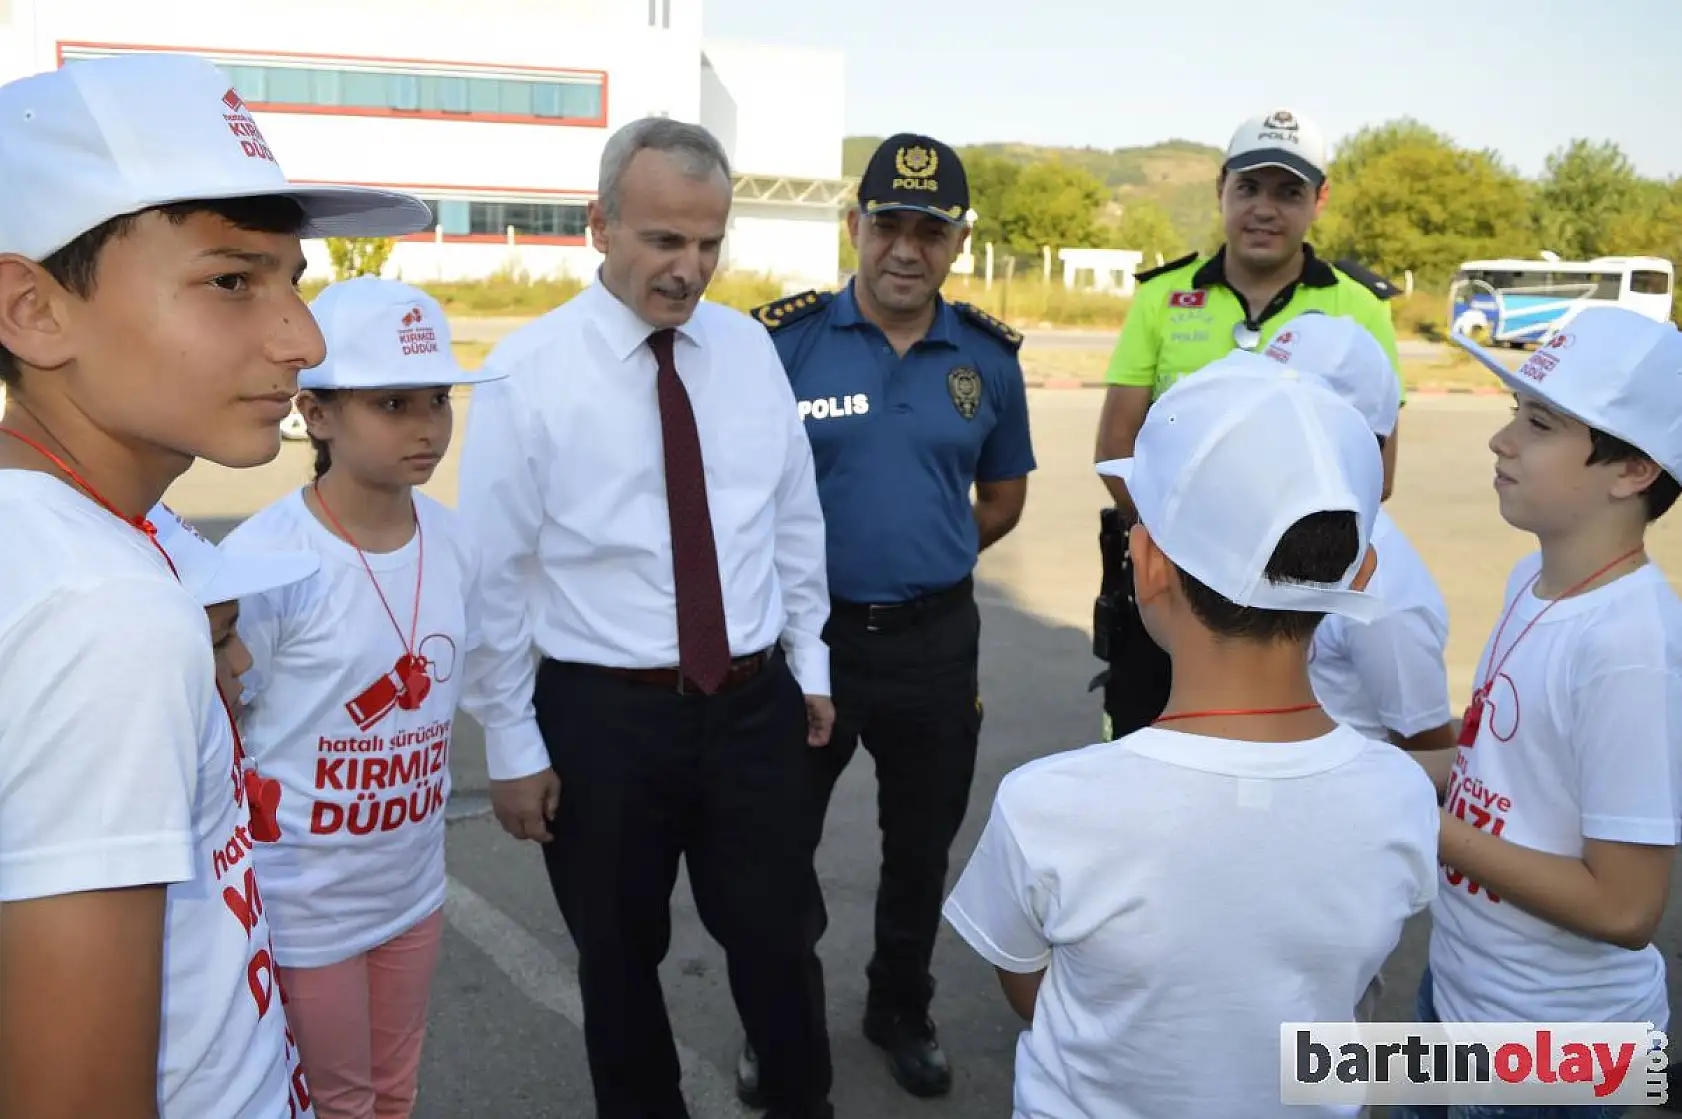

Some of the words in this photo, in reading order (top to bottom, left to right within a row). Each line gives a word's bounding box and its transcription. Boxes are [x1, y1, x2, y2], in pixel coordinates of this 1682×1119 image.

[314, 736, 449, 791] KIRMIZI
[317, 735, 384, 752] hatalı
[310, 776, 444, 836] DÜDÜK
[1461, 776, 1511, 812] cüye
